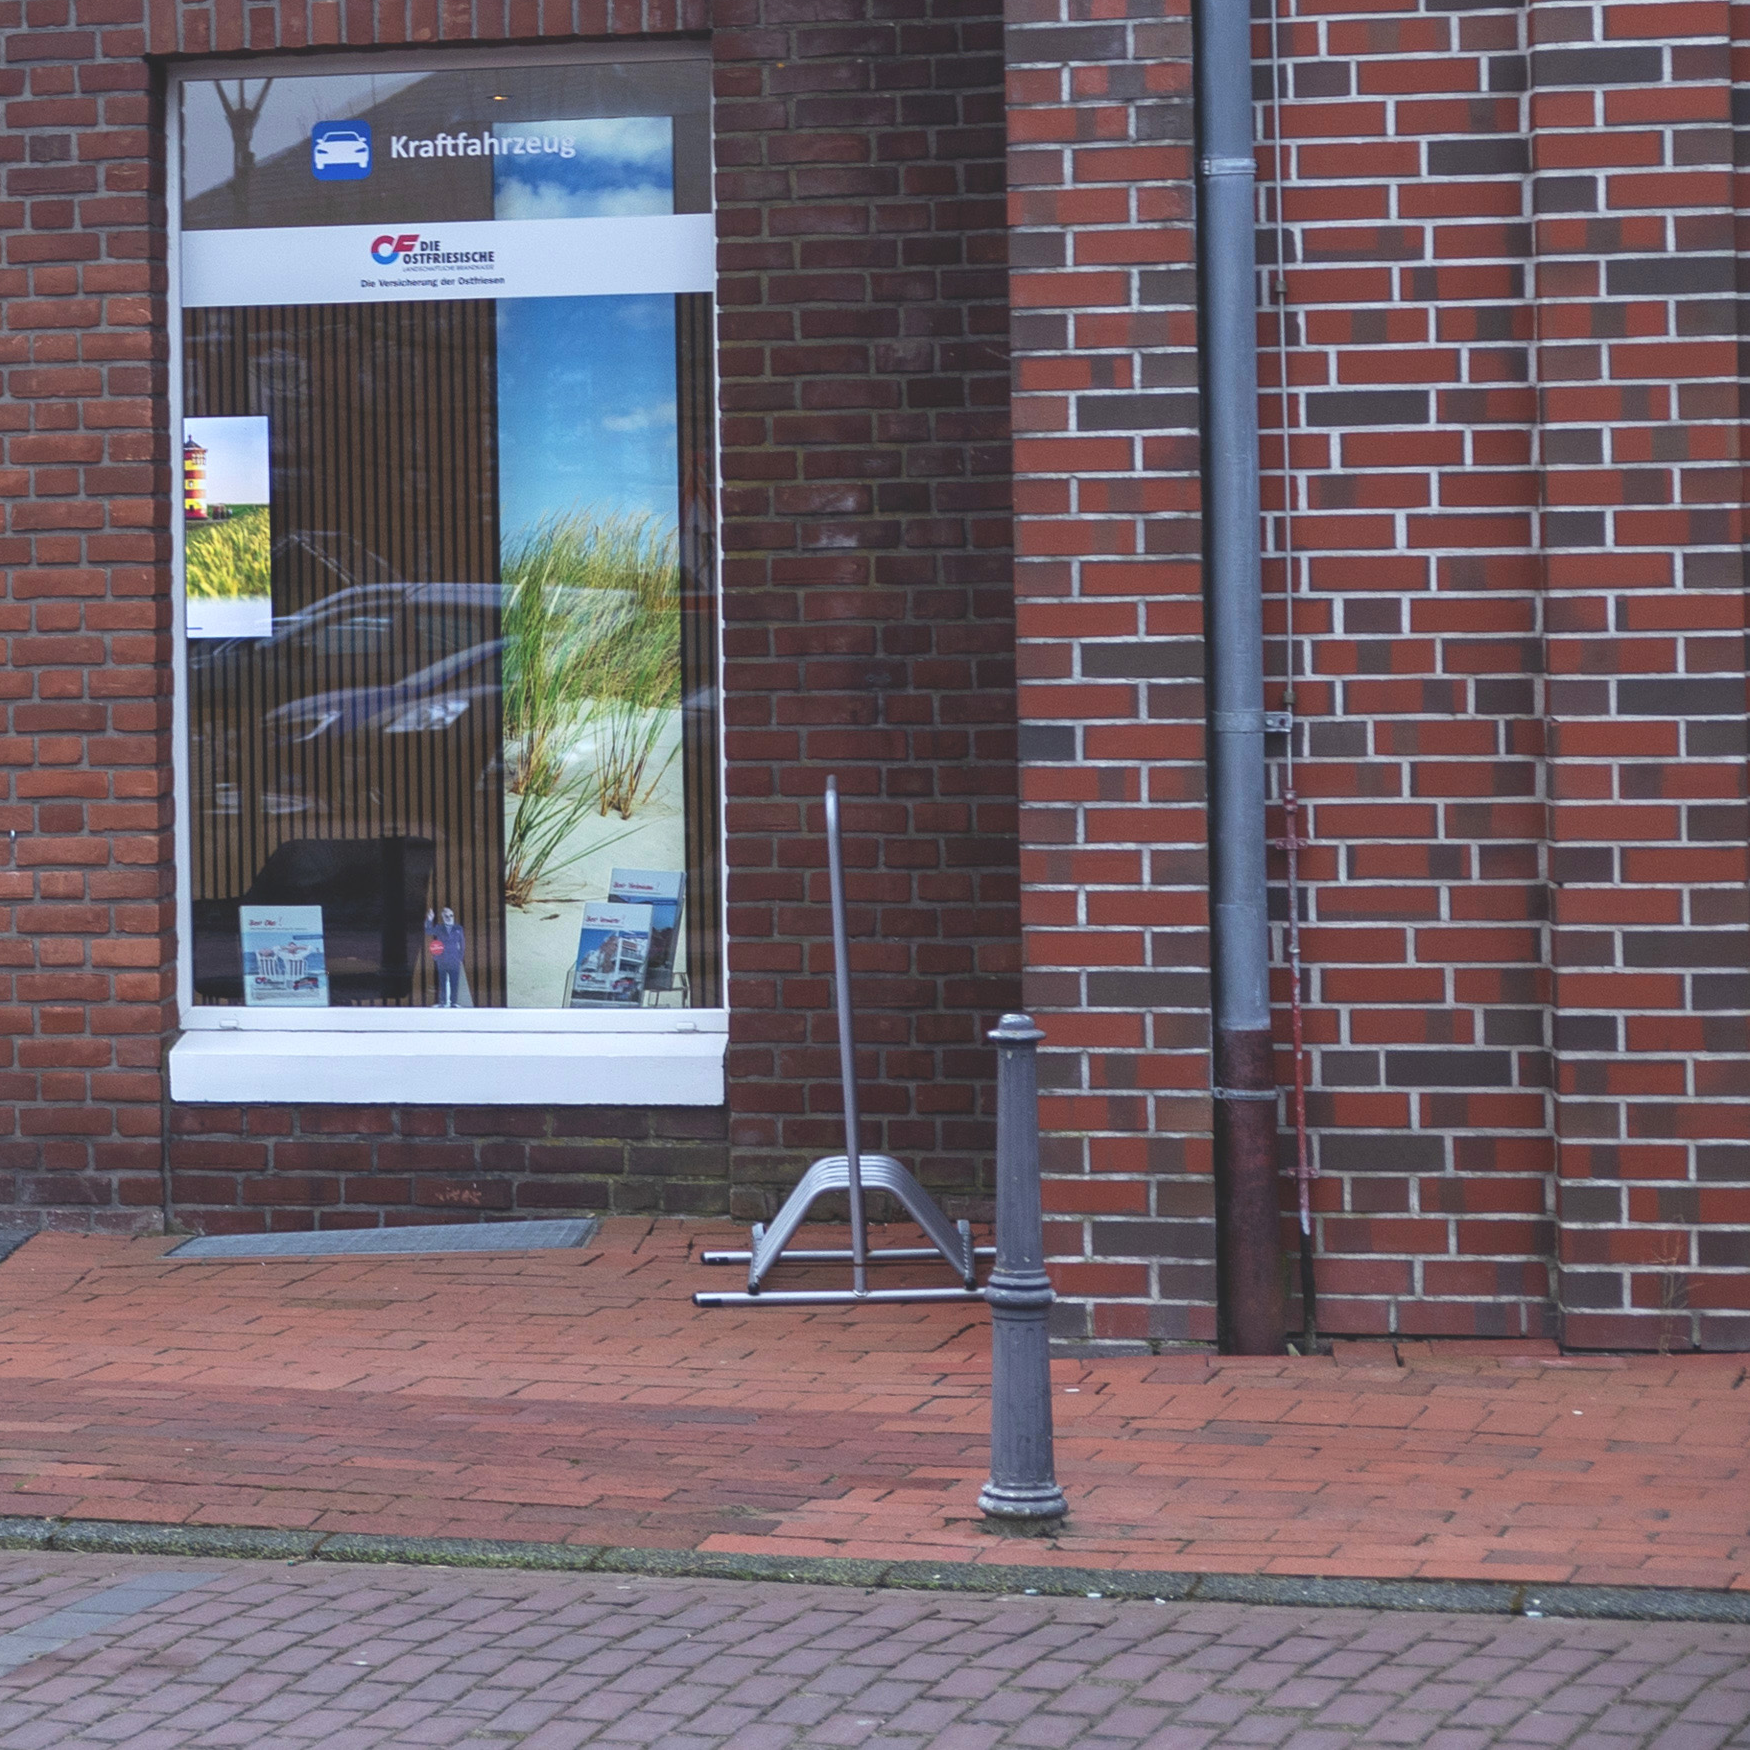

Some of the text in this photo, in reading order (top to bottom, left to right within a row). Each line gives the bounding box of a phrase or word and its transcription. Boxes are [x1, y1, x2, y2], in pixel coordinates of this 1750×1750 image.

[390, 131, 576, 159] Kraftfahrzeug
[420, 241, 441, 251] DIE
[403, 252, 494, 264] OSTFRIESISCHE
[379, 279, 438, 287] Versicherung
[441, 277, 455, 285] der
